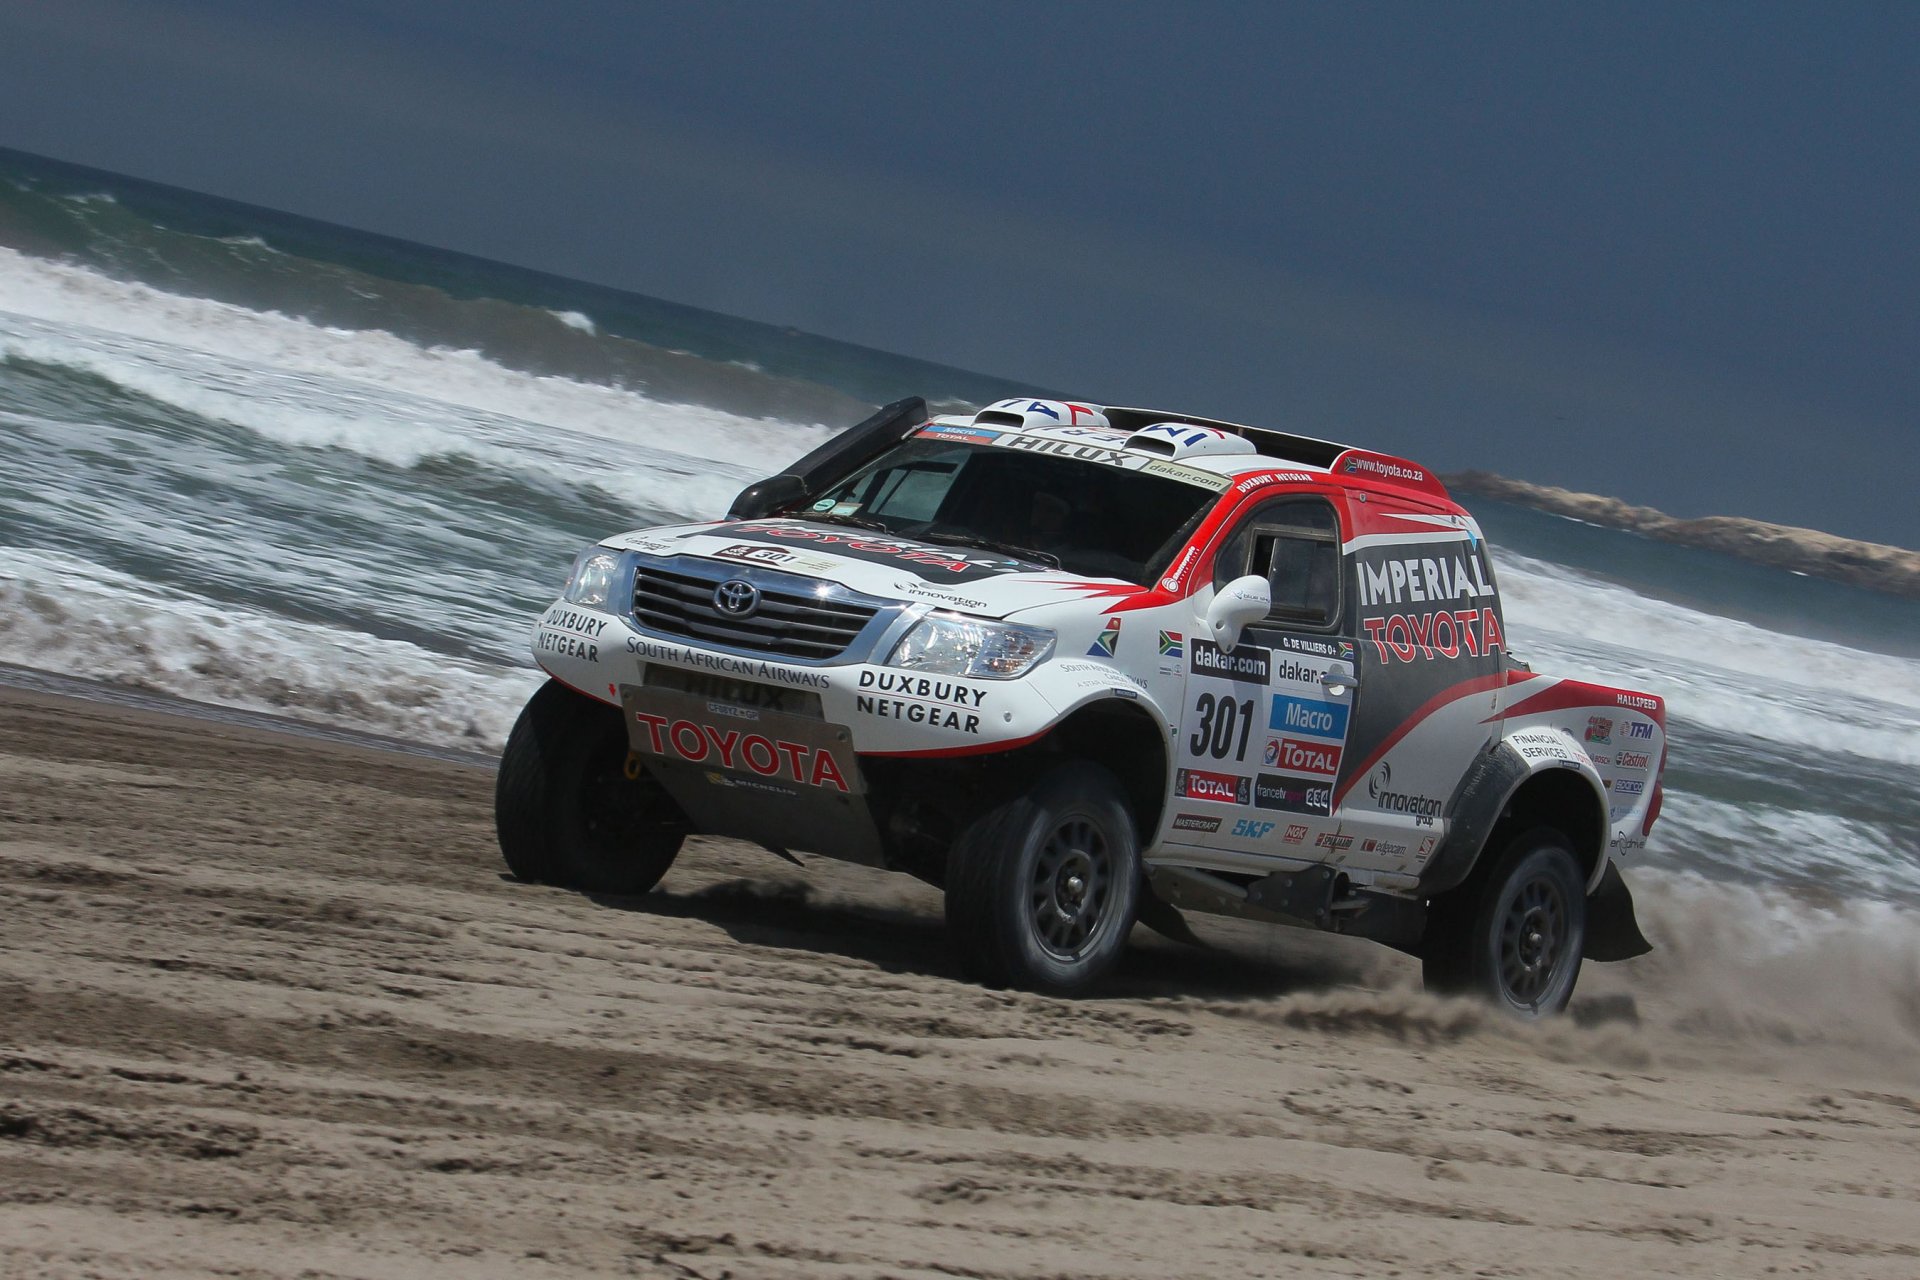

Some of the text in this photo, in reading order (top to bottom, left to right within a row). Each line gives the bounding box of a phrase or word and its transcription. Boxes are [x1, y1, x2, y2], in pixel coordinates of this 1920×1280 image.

[935, 432, 969, 441] TOTAL
[943, 427, 977, 435] Macro
[1008, 435, 1130, 467] HILUX
[1149, 462, 1222, 490] dakar.com
[1356, 458, 1424, 481] www.toyota.co.za
[1236, 473, 1313, 493] DUXBURY NETGEAR
[734, 526, 971, 573] TOYOTA
[755, 551, 797, 562] 301
[1356, 555, 1495, 606] IMPERIAL
[908, 589, 987, 608] innovation
[546, 609, 608, 637] DUXBURY
[538, 632, 599, 662] NETGEAR
[1291, 638, 1301, 649] DE
[1301, 640, 1327, 654] VILLIERS
[1363, 607, 1507, 665] TOYOTA
[1195, 646, 1266, 676] dakar.com
[1279, 659, 1328, 684] dakar.
[858, 670, 987, 707] DUXBURY
[1617, 693, 1657, 710] HALLSPEED
[857, 695, 980, 734] NETGEAR
[1285, 702, 1332, 731] Macro
[1189, 692, 1255, 762] 301
[1630, 721, 1653, 739] TFM
[636, 712, 849, 792] TOYOTA
[1512, 735, 1562, 746] FINANCIAL
[1284, 743, 1336, 771] TOTAL
[1522, 747, 1568, 760] SERVICES
[1594, 755, 1611, 764] BOSCH
[1621, 752, 1649, 768] Castrol
[735, 779, 797, 796] MICHELIN
[1190, 774, 1234, 797] TOTAL
[1378, 791, 1442, 817] innovation
[1175, 817, 1219, 831] MASTERCRAFT
[1231, 819, 1275, 838] SKF
[1415, 814, 1434, 829] group
[1285, 827, 1306, 840] NGK
